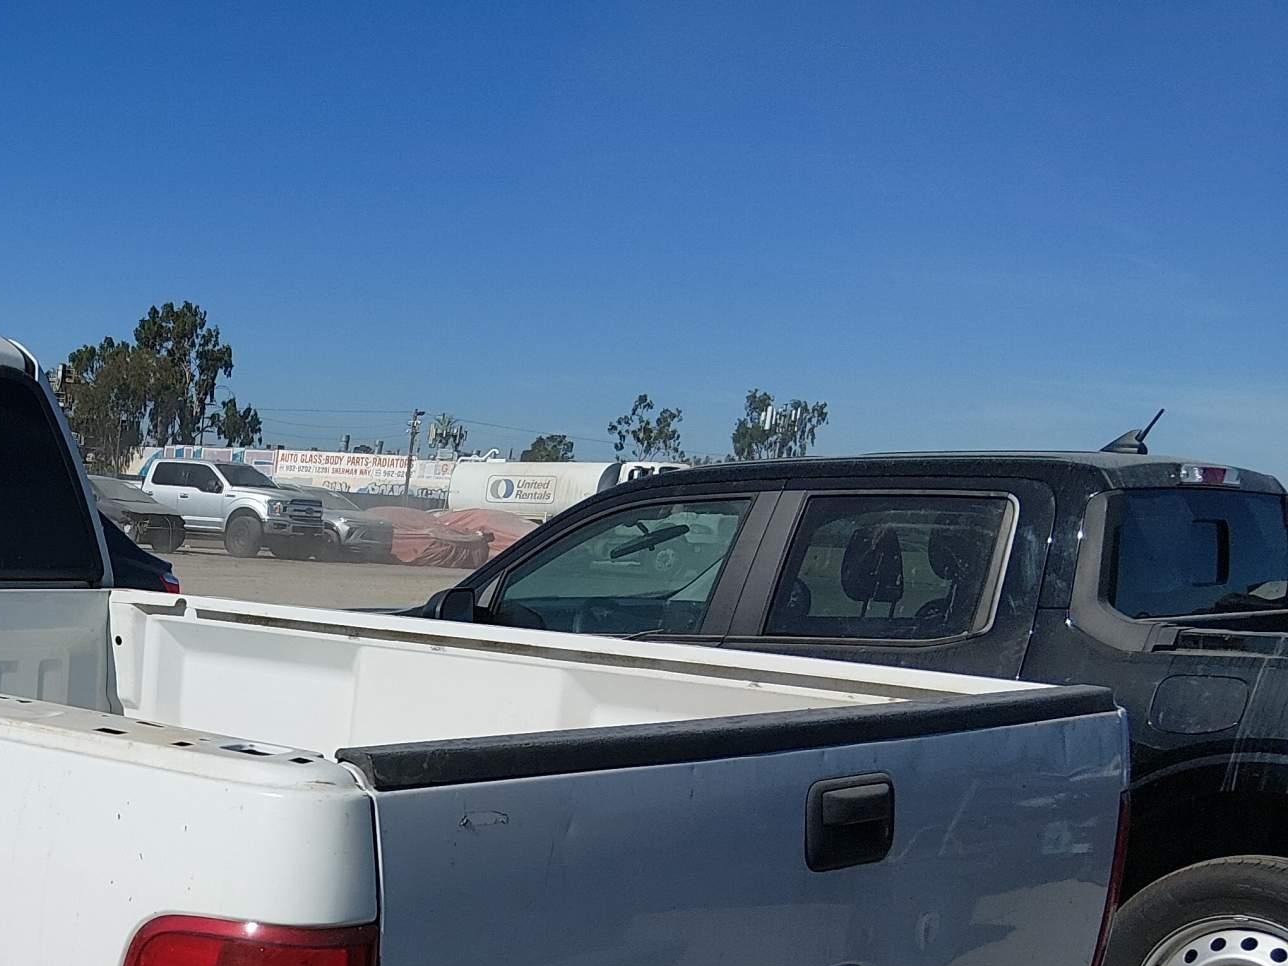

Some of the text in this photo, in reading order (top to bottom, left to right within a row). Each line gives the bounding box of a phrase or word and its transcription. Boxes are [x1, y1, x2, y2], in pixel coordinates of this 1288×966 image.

[280, 453, 299, 463] AUTO
[516, 479, 551, 490] United
[515, 489, 552, 501] Rentals
